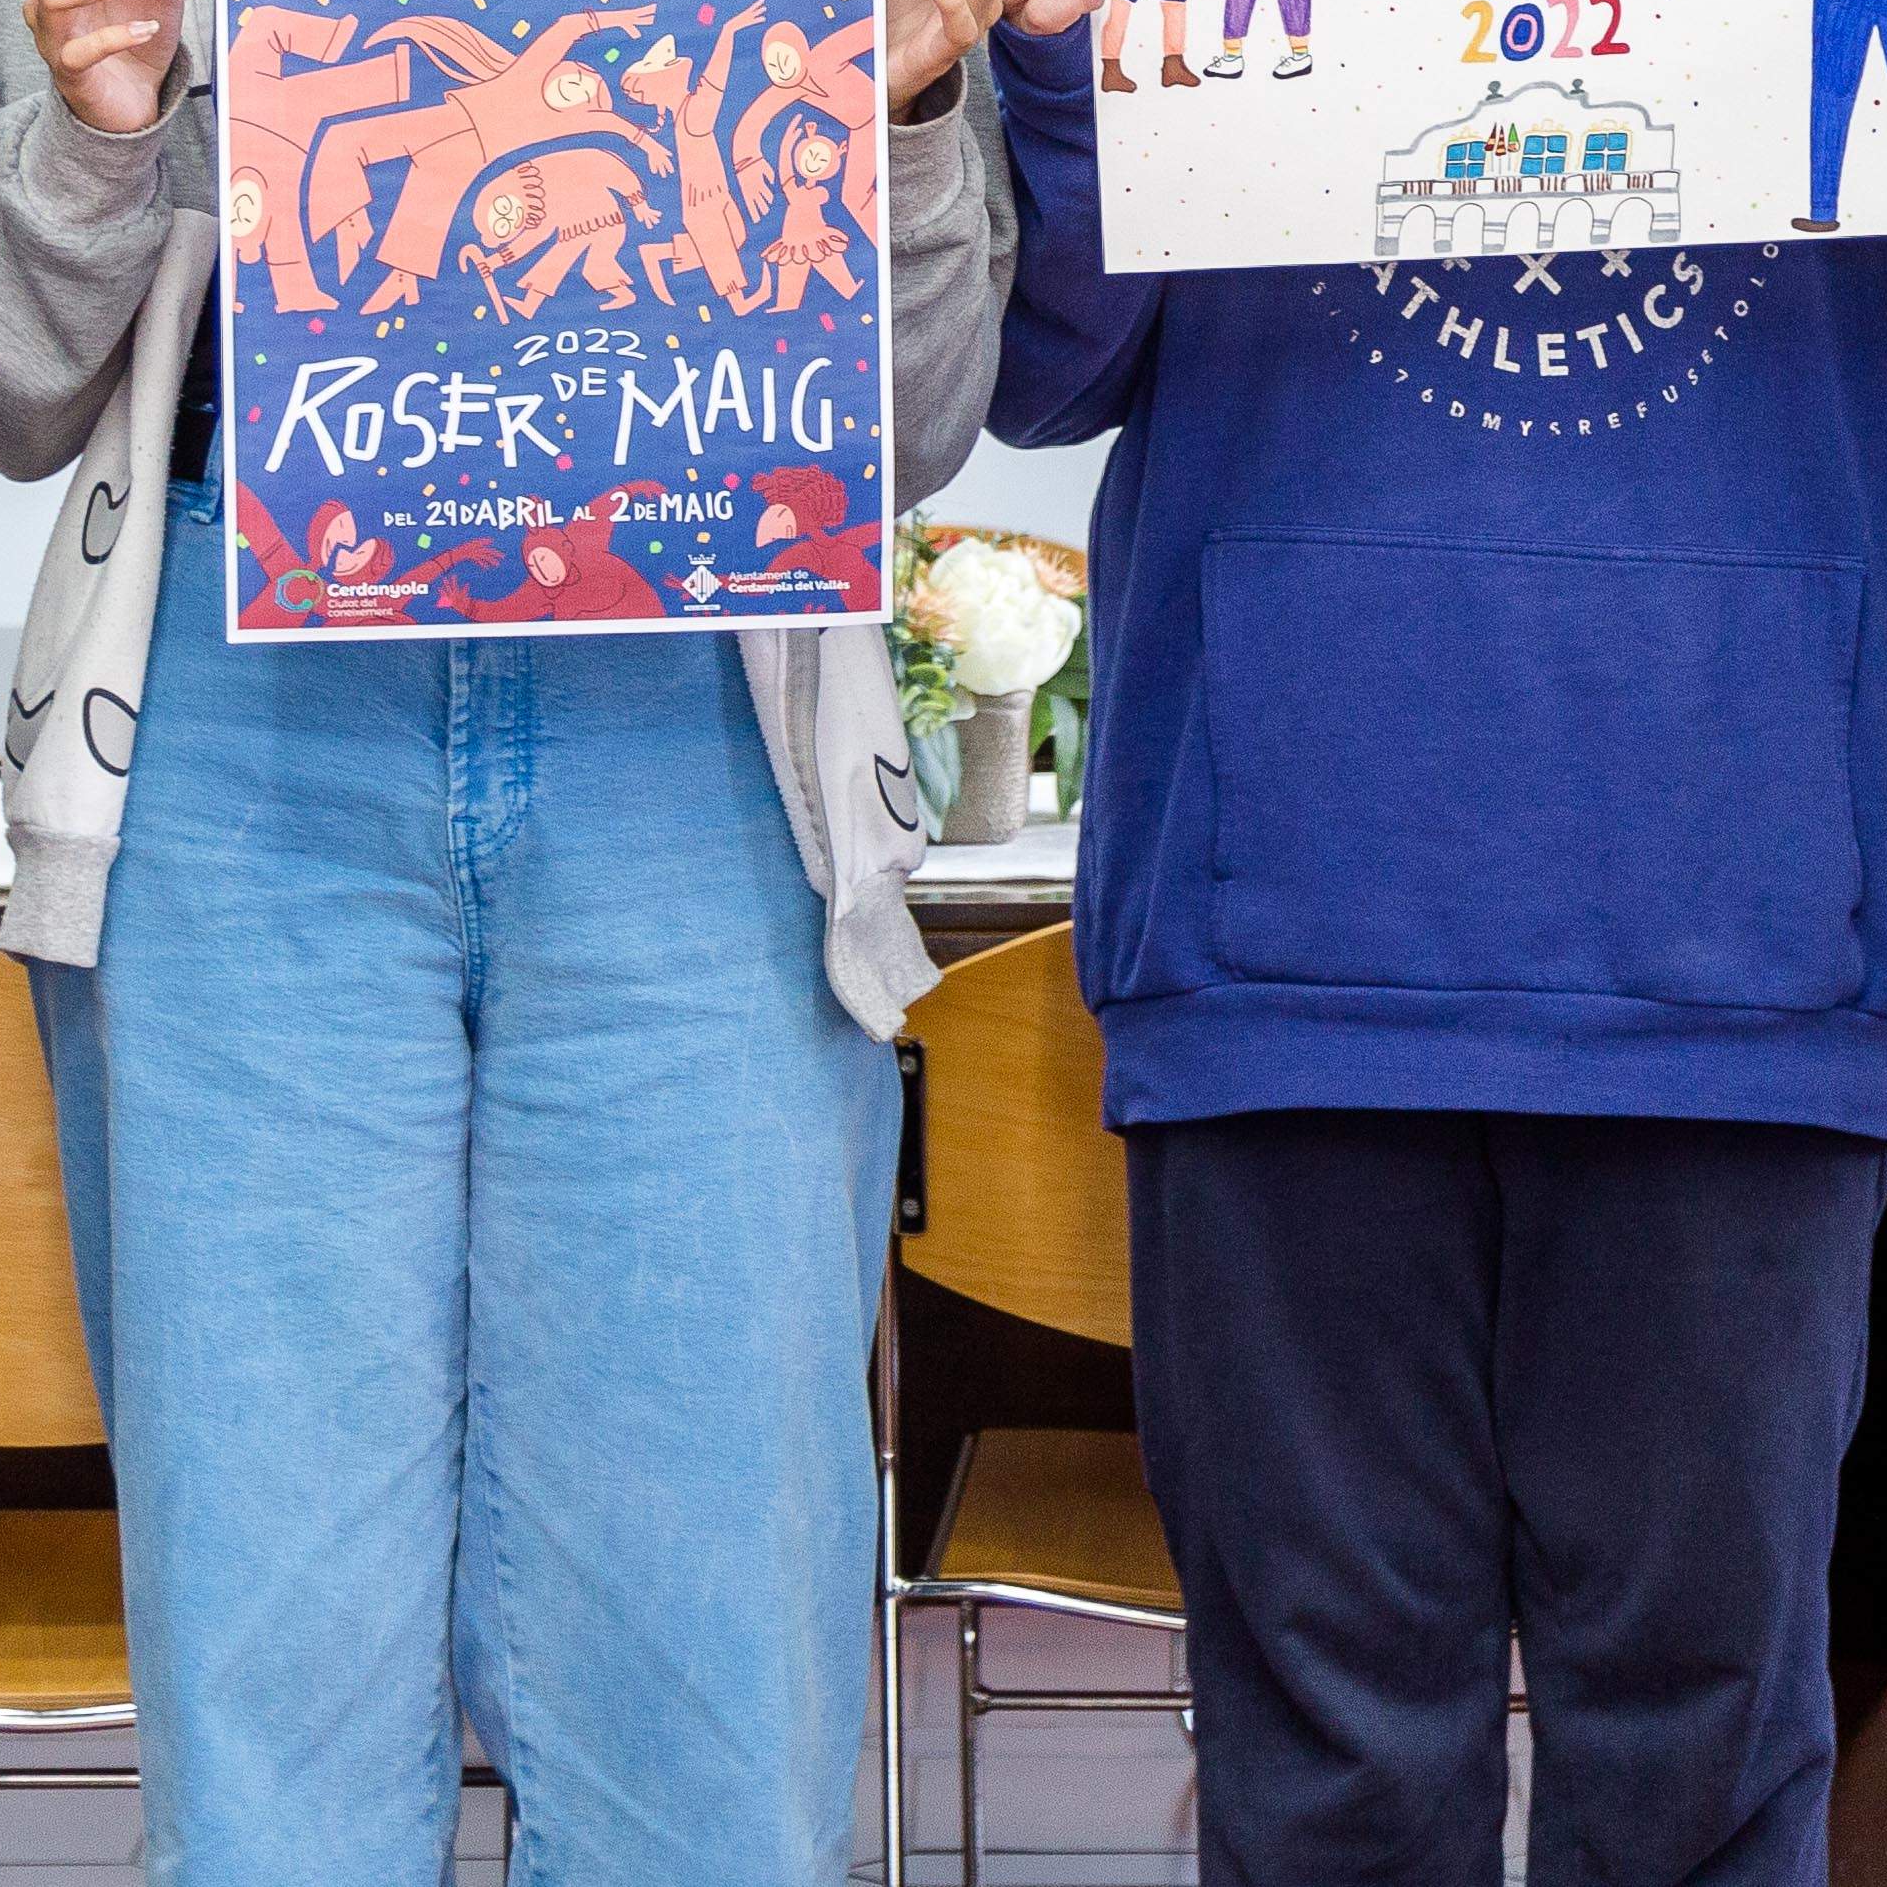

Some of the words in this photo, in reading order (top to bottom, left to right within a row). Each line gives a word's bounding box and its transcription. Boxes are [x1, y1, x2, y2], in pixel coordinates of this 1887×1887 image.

[513, 327, 647, 367] 2022
[264, 356, 562, 477] ROSER
[551, 366, 607, 402] DE
[614, 348, 834, 466] MAIG
[383, 510, 417, 527] DEL
[572, 505, 596, 521] AL
[659, 490, 734, 523] MAIG
[326, 580, 429, 599] Cerdanyola
[728, 570, 791, 583] Ajuntament
[793, 569, 809, 580] de
[728, 581, 793, 595] Cerdanyola
[795, 579, 813, 591] del
